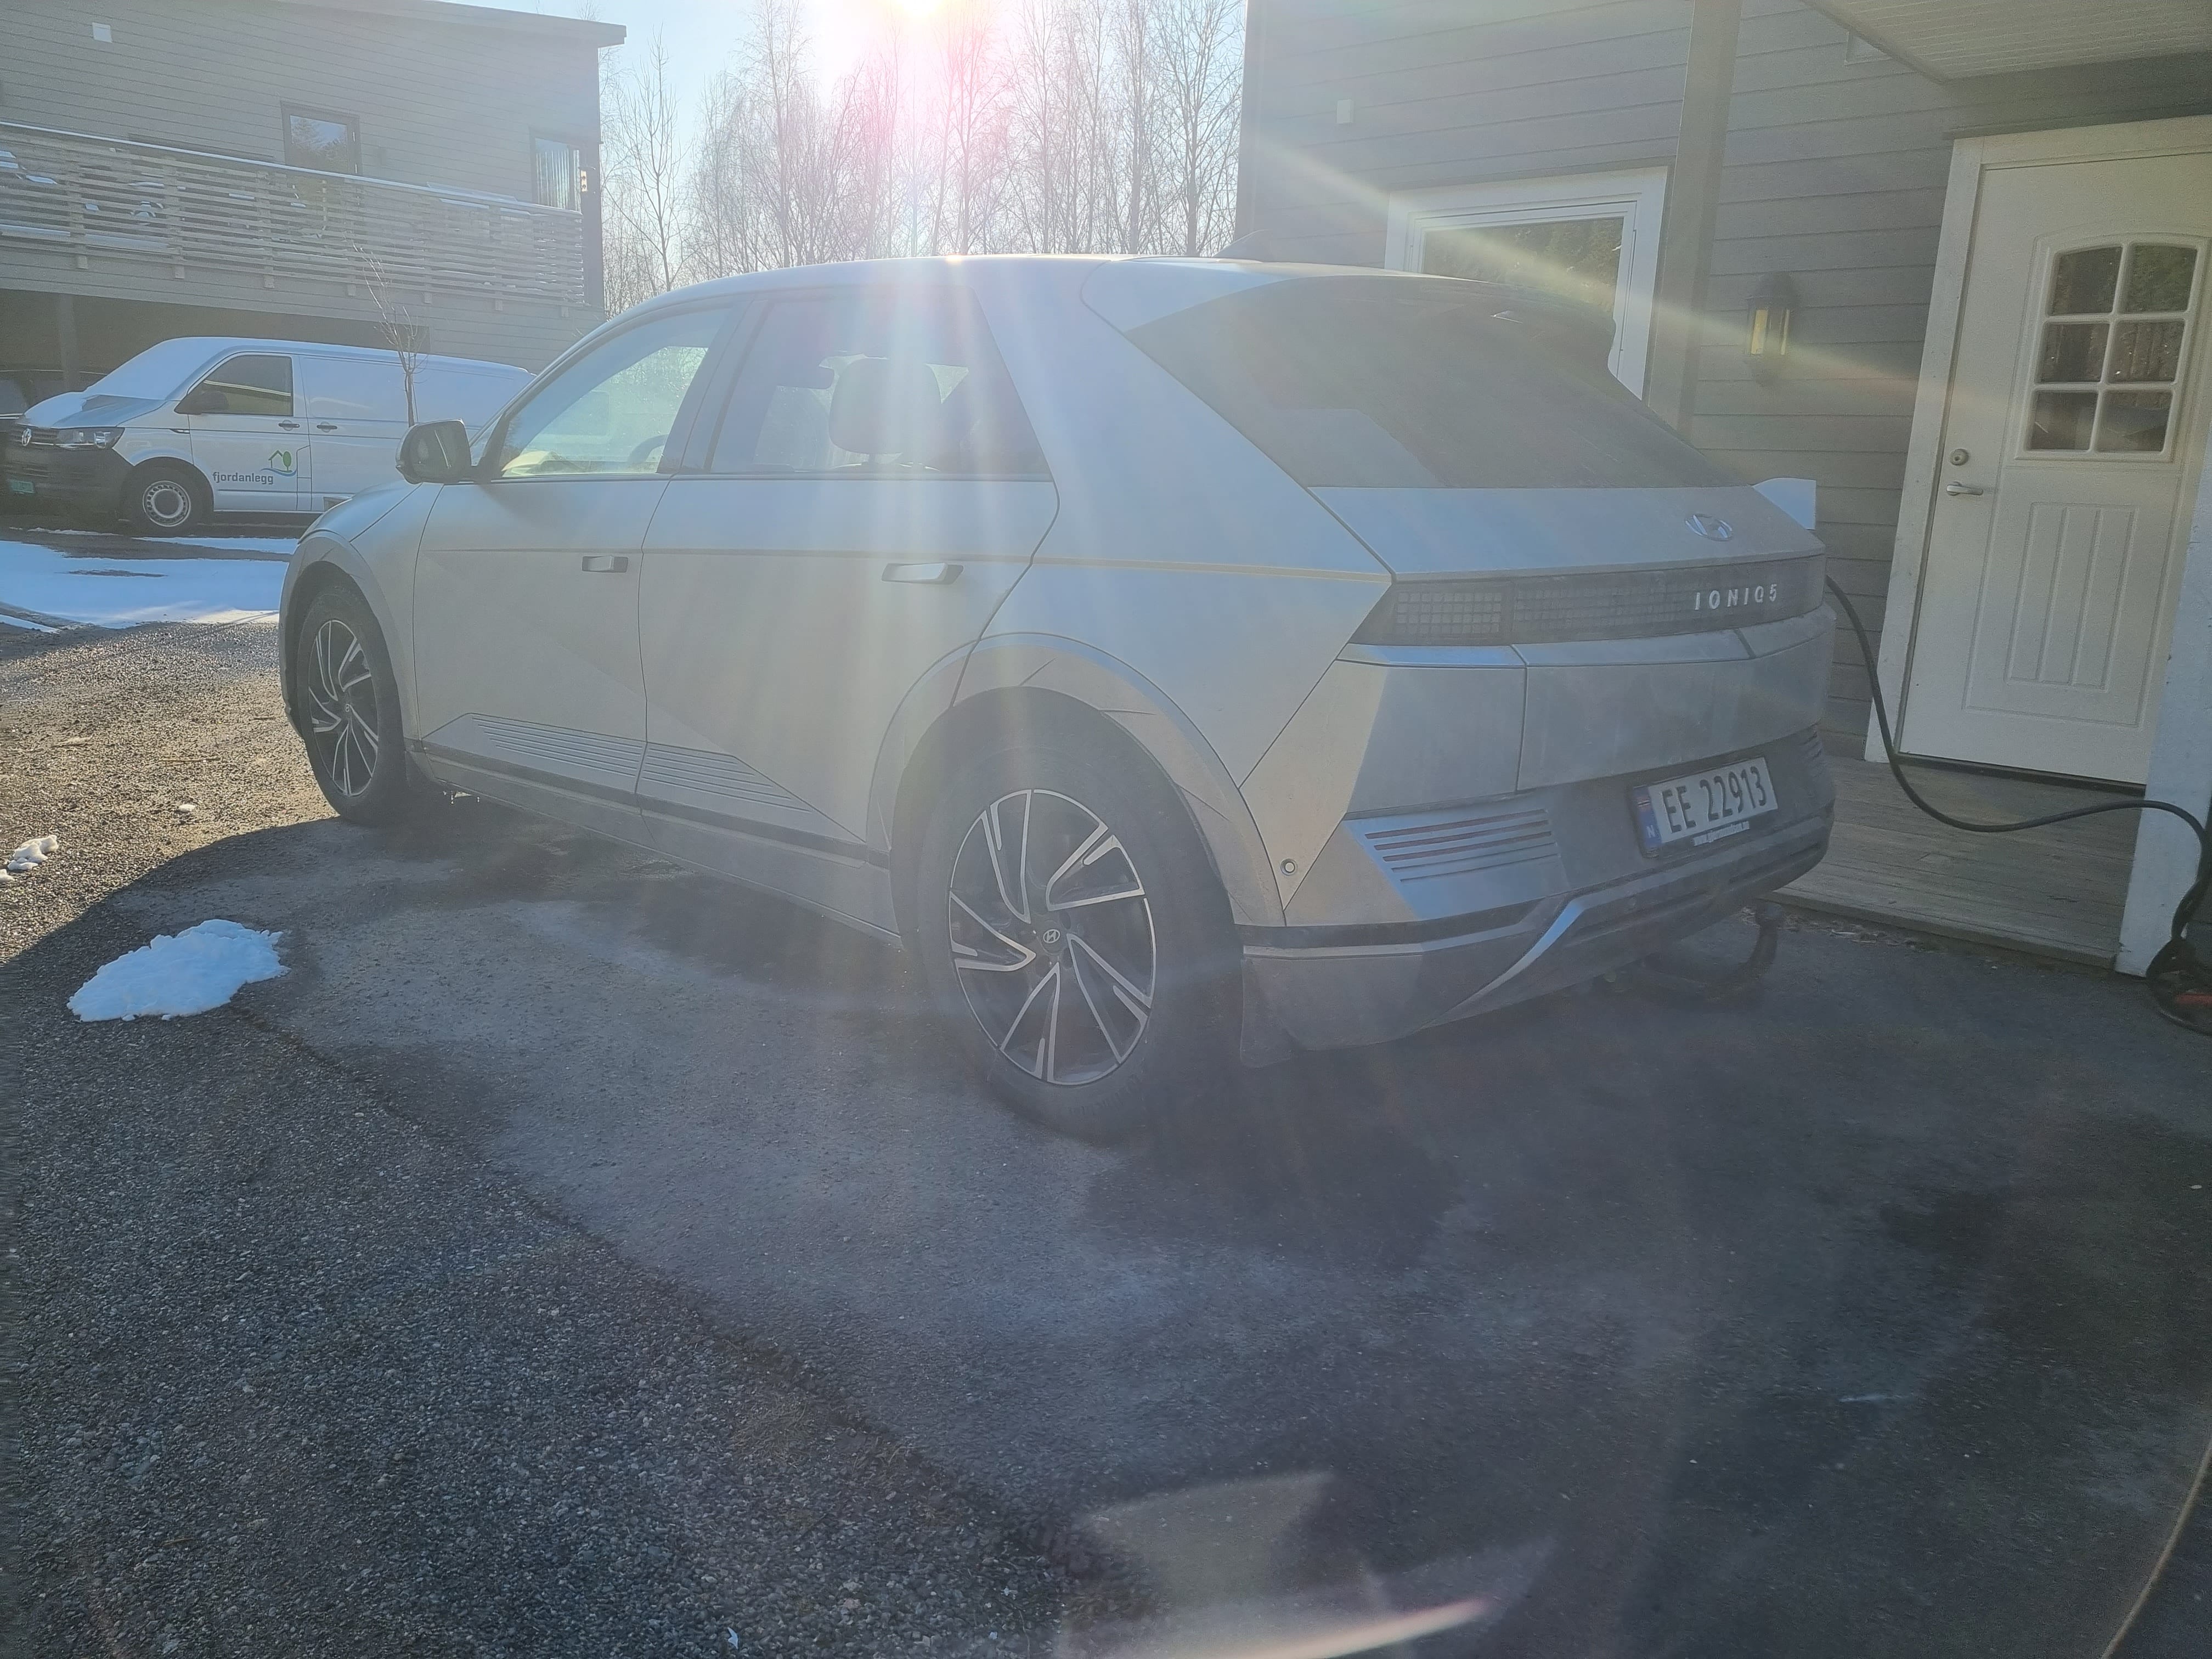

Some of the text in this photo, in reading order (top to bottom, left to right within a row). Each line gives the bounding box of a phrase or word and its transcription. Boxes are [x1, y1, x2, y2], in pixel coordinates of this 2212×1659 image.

[212, 471, 274, 484] fjordanlegg
[1662, 785, 1696, 833] EE
[1700, 766, 1767, 821] 22913
[1646, 825, 1655, 838] N
